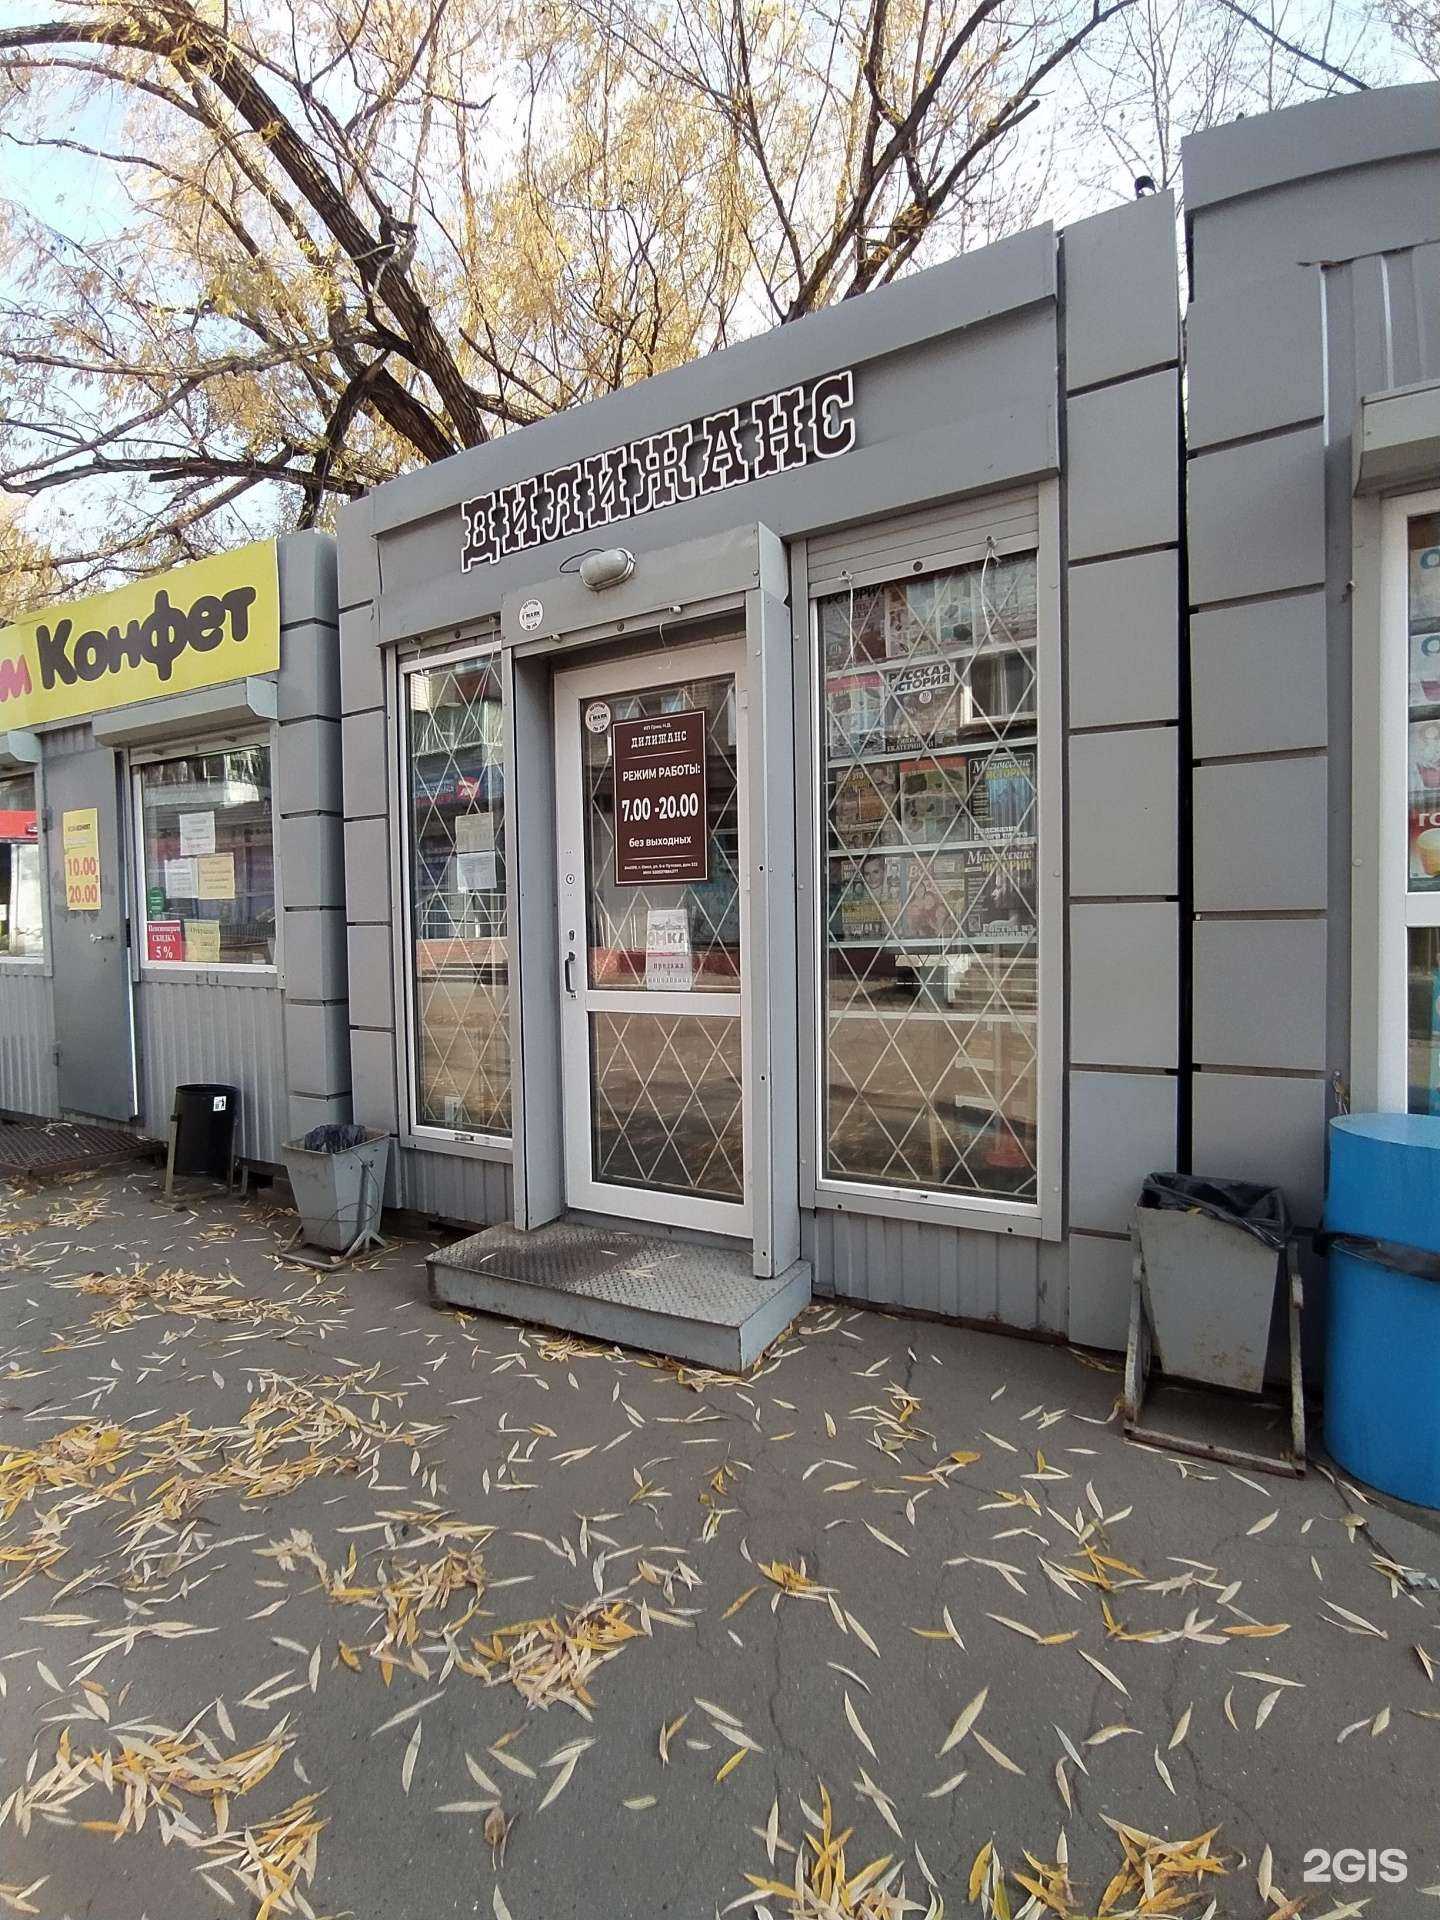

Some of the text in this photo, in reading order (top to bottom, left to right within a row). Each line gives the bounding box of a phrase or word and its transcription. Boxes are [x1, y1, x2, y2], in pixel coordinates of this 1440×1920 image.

[461, 371, 856, 574] ДИЛИЖАНС
[36, 587, 257, 690] Конфет
[889, 664, 951, 682] РУССКАЯ
[890, 673, 950, 692] ИСТОРИЯ
[631, 731, 687, 748] ДИЛИЖАНС
[622, 763, 701, 782] РЕЖИМ РАБОТЫ:
[621, 797, 651, 822] 7.00
[629, 835, 692, 848] без выходных
[68, 857, 97, 876] 10.00
[68, 884, 98, 903] 20.00
[152, 934, 176, 942] СКИДКА
